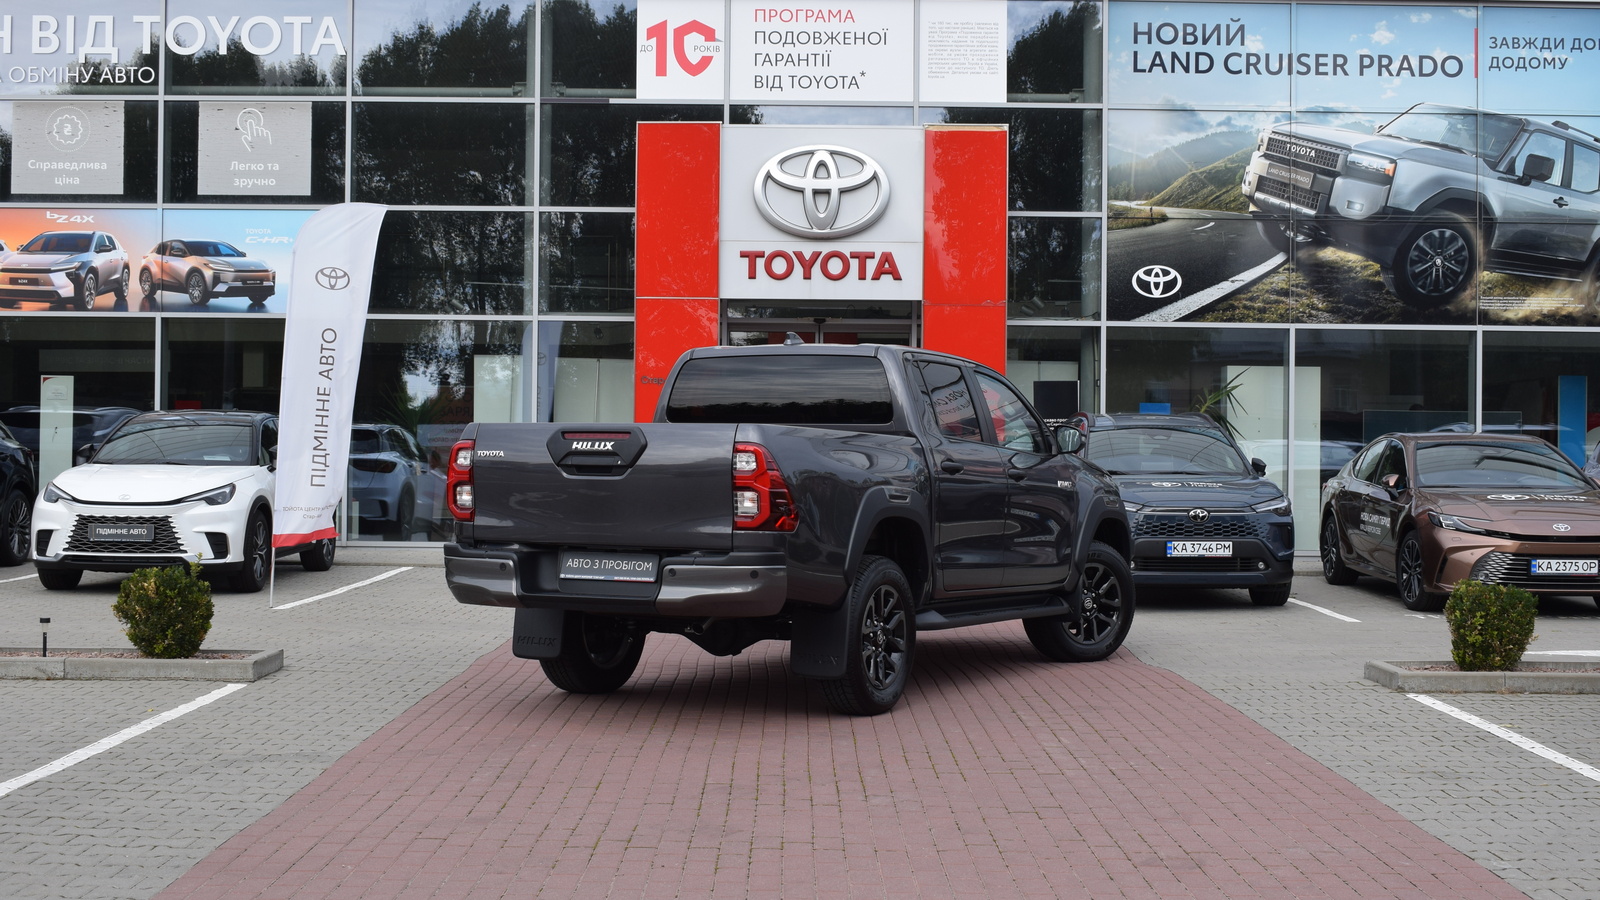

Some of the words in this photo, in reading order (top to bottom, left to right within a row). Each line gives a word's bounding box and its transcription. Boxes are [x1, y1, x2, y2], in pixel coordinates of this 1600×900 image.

[754, 8, 855, 23] ПРОГРАМА
[32, 15, 118, 63] ВІД
[133, 15, 347, 56] TOYOTA
[754, 28, 889, 48] ПОДОВЖЕНОЇ
[1132, 18, 1246, 46] НОВИЙ
[640, 45, 653, 53] ДО
[1489, 36, 1564, 52] ЗАВЖДИ
[754, 50, 832, 67] ГАРАНТІЇ
[1132, 52, 1214, 74] LAND
[1223, 52, 1349, 77] CRUISER
[1359, 54, 1464, 78] PRADO
[1489, 57, 1568, 72] ДОДОМУ
[9, 66, 94, 83] ОБМІНУ
[100, 67, 155, 83] АВТО
[754, 75, 783, 92] ВІД
[1287, 144, 1315, 157] TOYOTA
[28, 160, 107, 172] Справедлива
[230, 161, 264, 170] Легко
[55, 174, 80, 186] ціна
[234, 178, 276, 188] зручно
[1296, 175, 1310, 183] PRADO
[740, 250, 902, 282] TOYOTA
[319, 328, 337, 380] АВТО
[310, 386, 331, 487] ПІДМІННЕ
[572, 442, 615, 450] HILUX
[1173, 543, 1188, 553] KA
[1190, 543, 1214, 553] 3746
[1215, 543, 1231, 553] PM
[566, 558, 591, 568] АВТО
[601, 560, 652, 571] ПРОБІГОМ
[1537, 562, 1553, 571] KA
[1555, 562, 1580, 571] 2375
[1582, 562, 1596, 571] OP
[517, 636, 557, 647] HILUX
